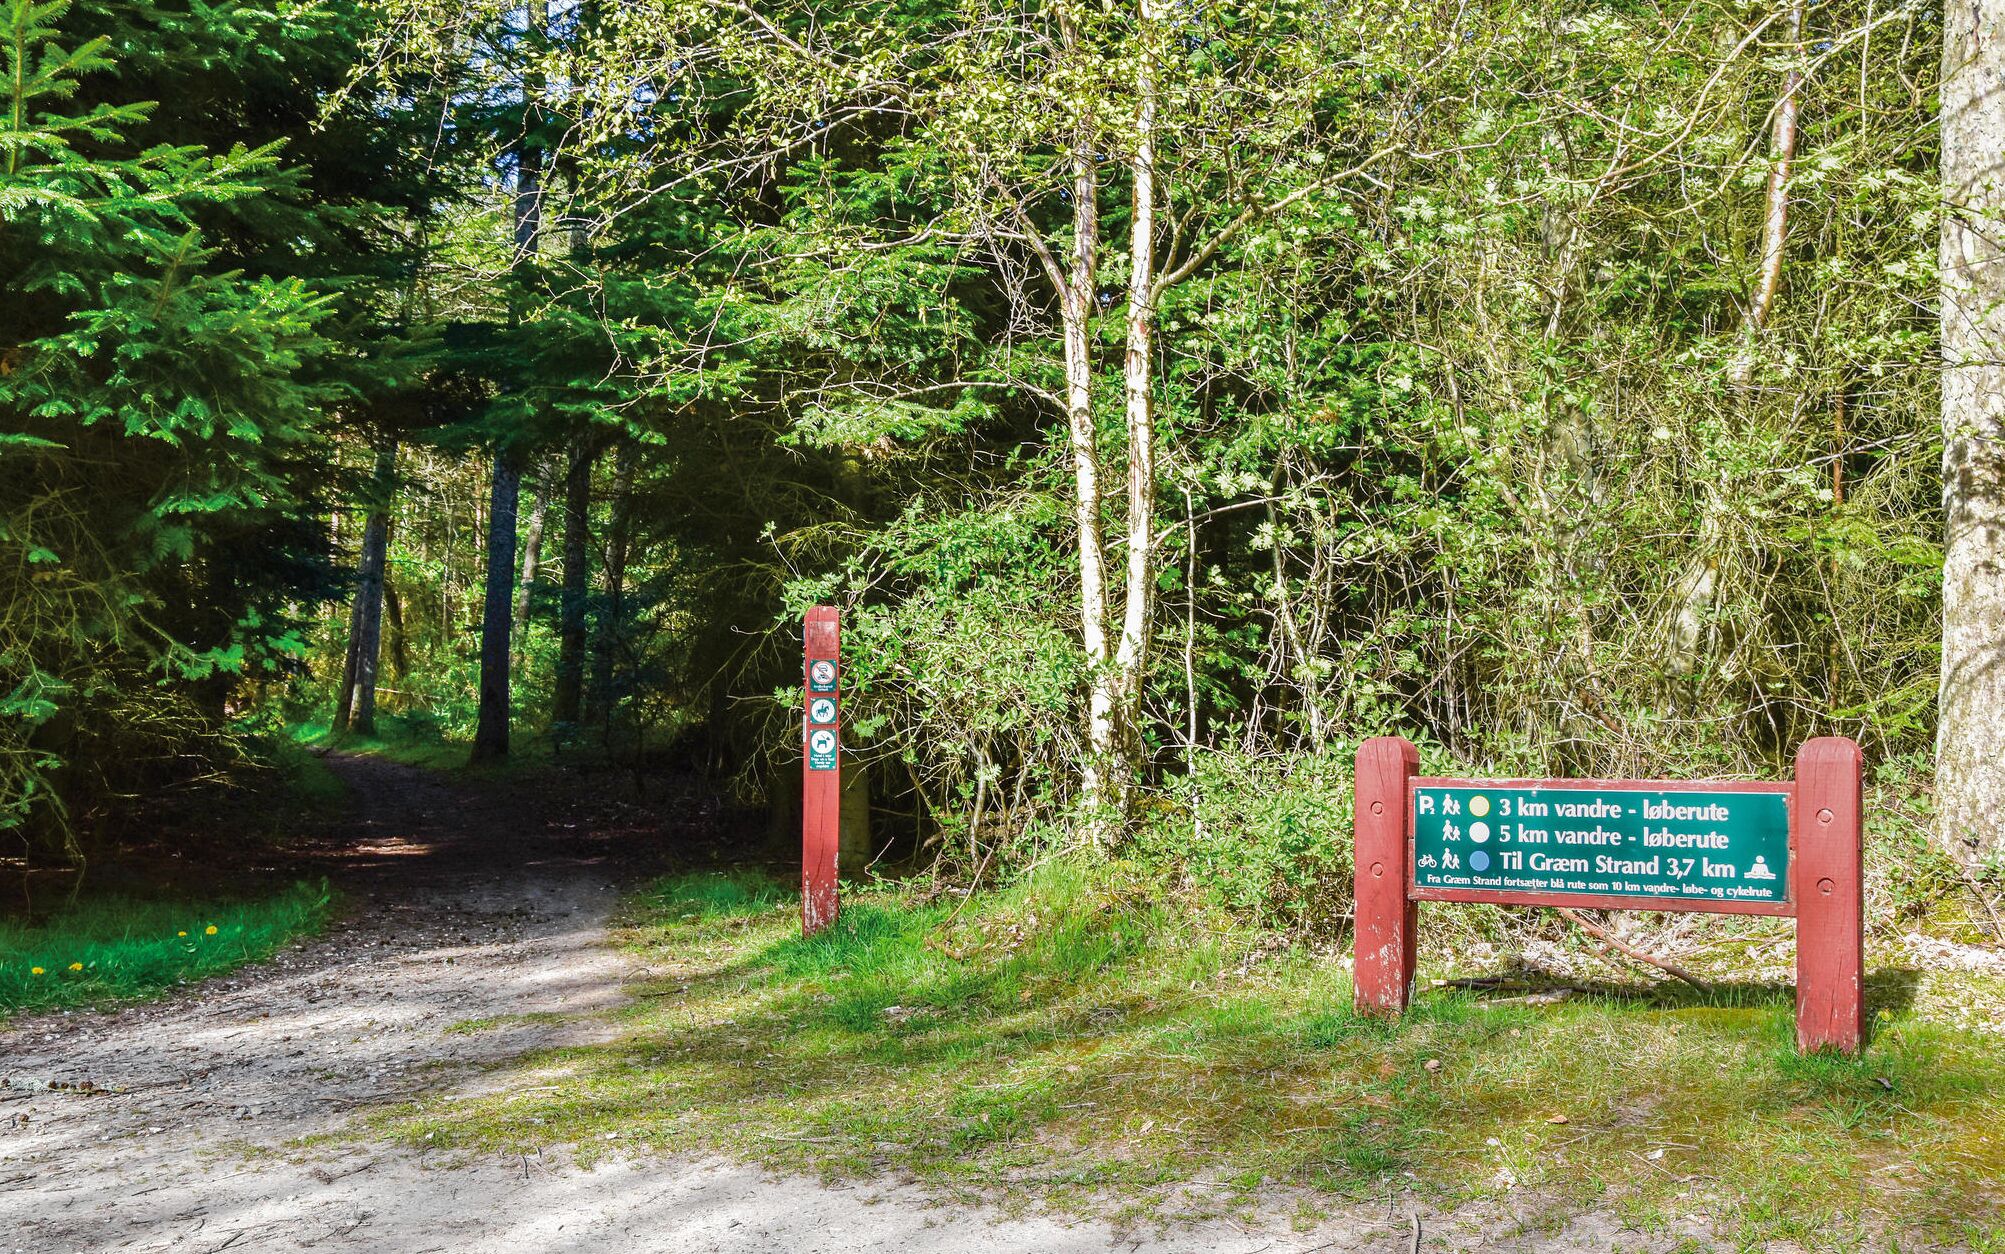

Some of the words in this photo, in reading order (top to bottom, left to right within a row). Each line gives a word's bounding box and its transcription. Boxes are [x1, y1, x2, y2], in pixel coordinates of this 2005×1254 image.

[1499, 798, 1511, 817] 3
[1517, 796, 1548, 817] km
[1554, 798, 1622, 819] vandre
[1643, 799, 1729, 822] løberute
[1499, 824, 1511, 843] 5
[1517, 823, 1548, 844] km
[1554, 825, 1622, 846] vandre
[1643, 826, 1729, 849] løberute
[1499, 851, 1523, 870] Til
[1529, 853, 1589, 873] Græm
[1595, 854, 1659, 875] Strand
[1666, 857, 1695, 880] 3,7
[1702, 857, 1735, 878] km
[1427, 874, 1441, 884] Fra
[1443, 874, 1470, 885] Græm
[1473, 875, 1502, 886] Strand
[1504, 876, 1548, 888] fortsætter
[1551, 878, 1564, 889] blå
[1567, 880, 1586, 890] rute
[1589, 881, 1608, 891] som
[1612, 881, 1622, 891] 10
[1625, 881, 1640, 892] km
[1643, 882, 1680, 894] vandre-
[1682, 884, 1708, 894] løbe-
[1711, 887, 1723, 897] og
[1726, 885, 1773, 898] cykelrute
